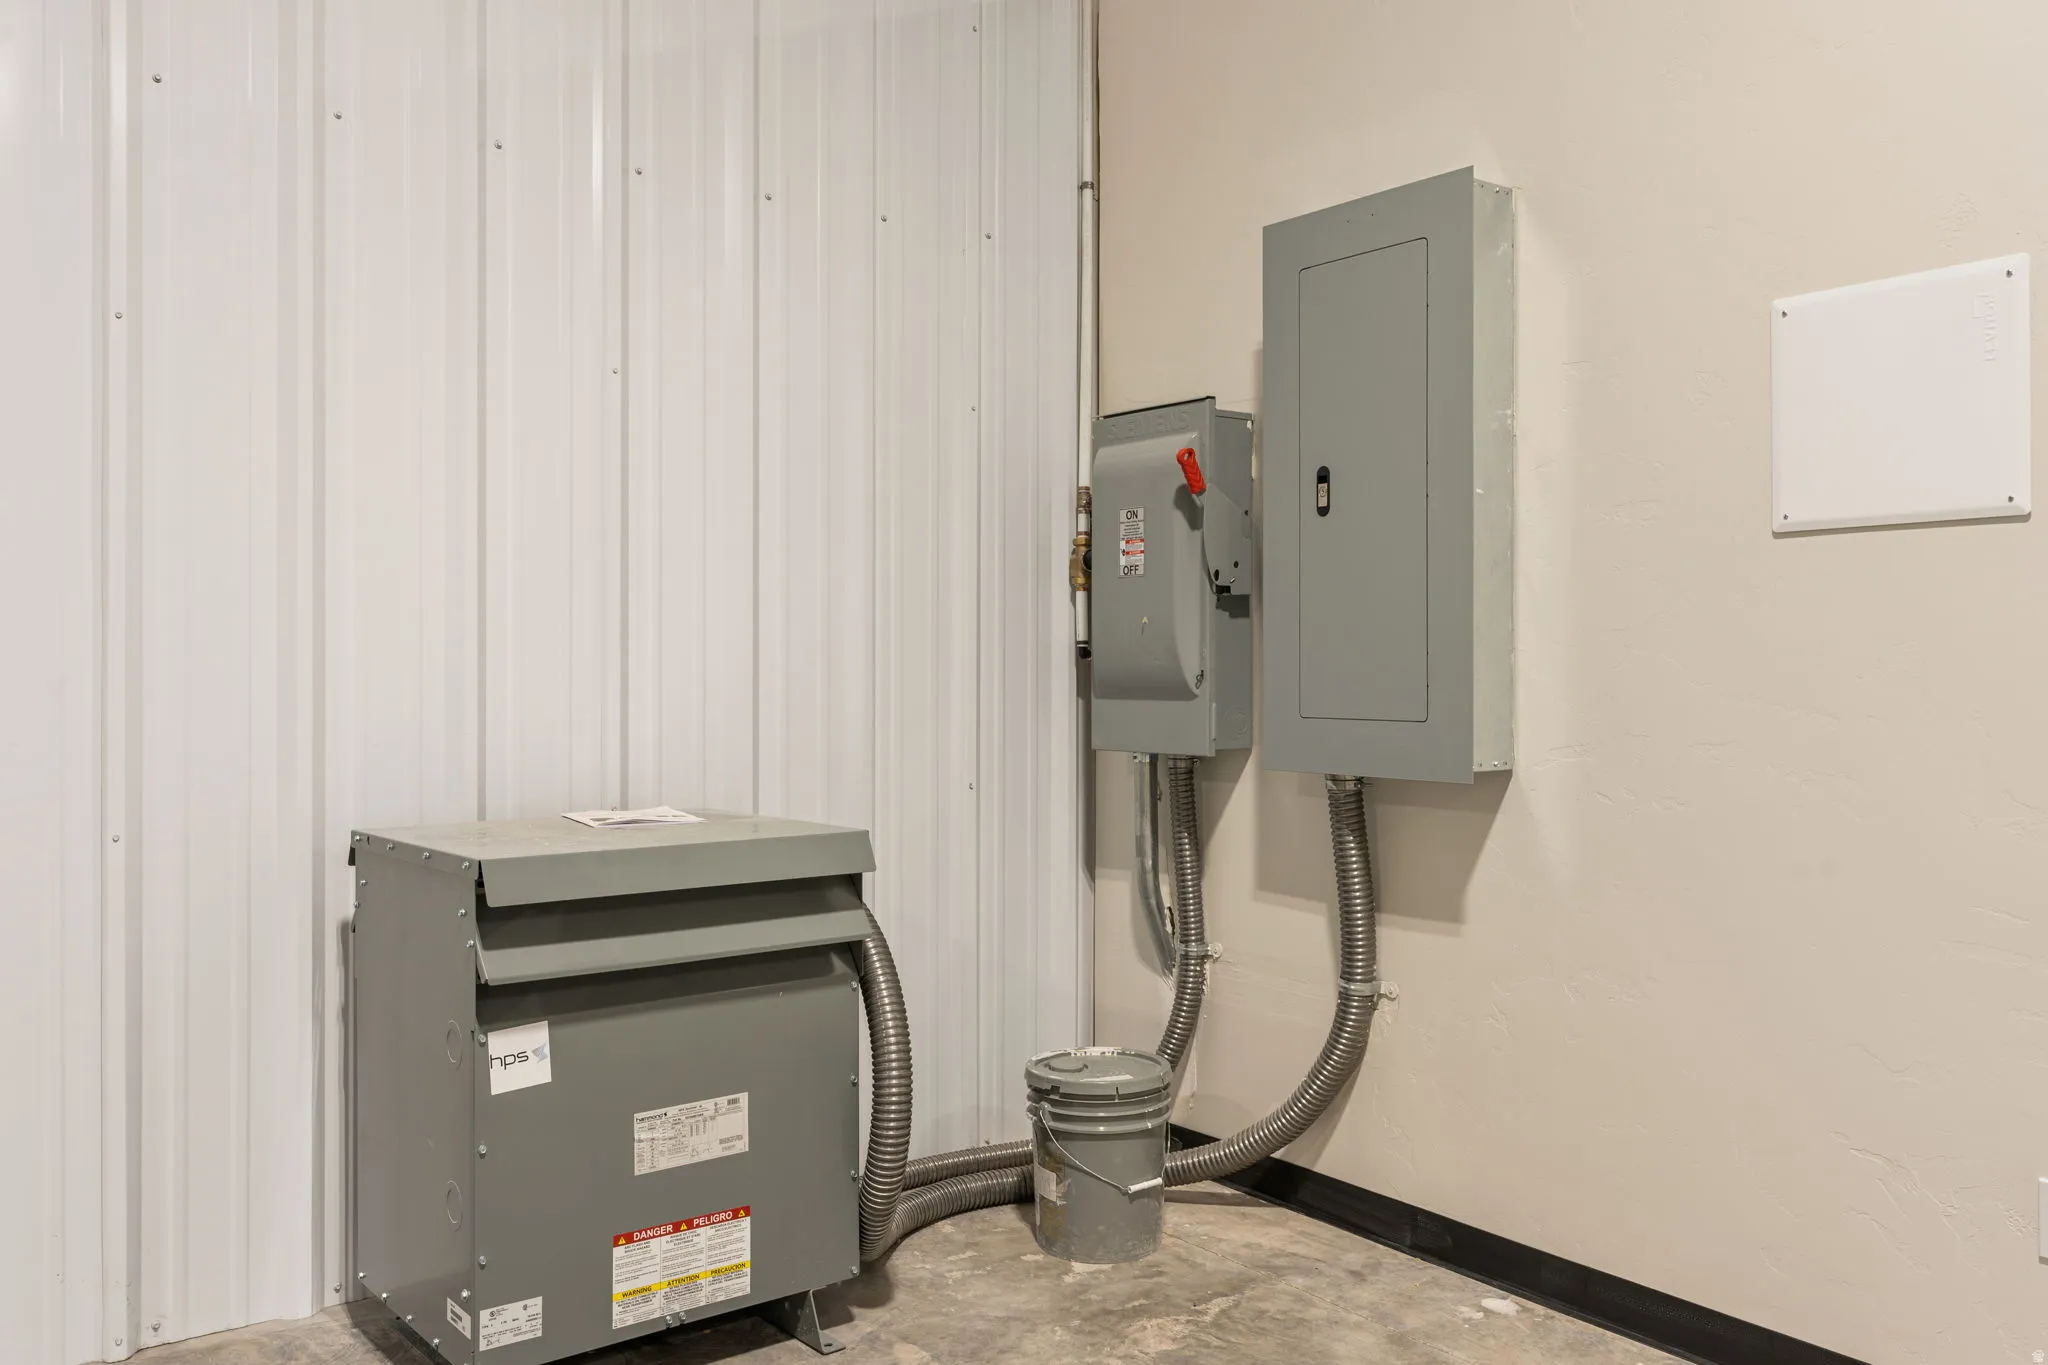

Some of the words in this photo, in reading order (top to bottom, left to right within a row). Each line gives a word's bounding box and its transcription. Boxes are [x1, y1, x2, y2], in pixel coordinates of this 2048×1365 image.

[1107, 408, 1191, 440] SIEMENS
[1125, 510, 1138, 520] ON
[1122, 565, 1139, 576] OFF
[489, 1051, 529, 1070] hps
[633, 1224, 673, 1241] DANGER
[693, 1211, 733, 1227] PELIGRO
[621, 1286, 652, 1298] WARNING
[666, 1274, 700, 1287] ATTENTION
